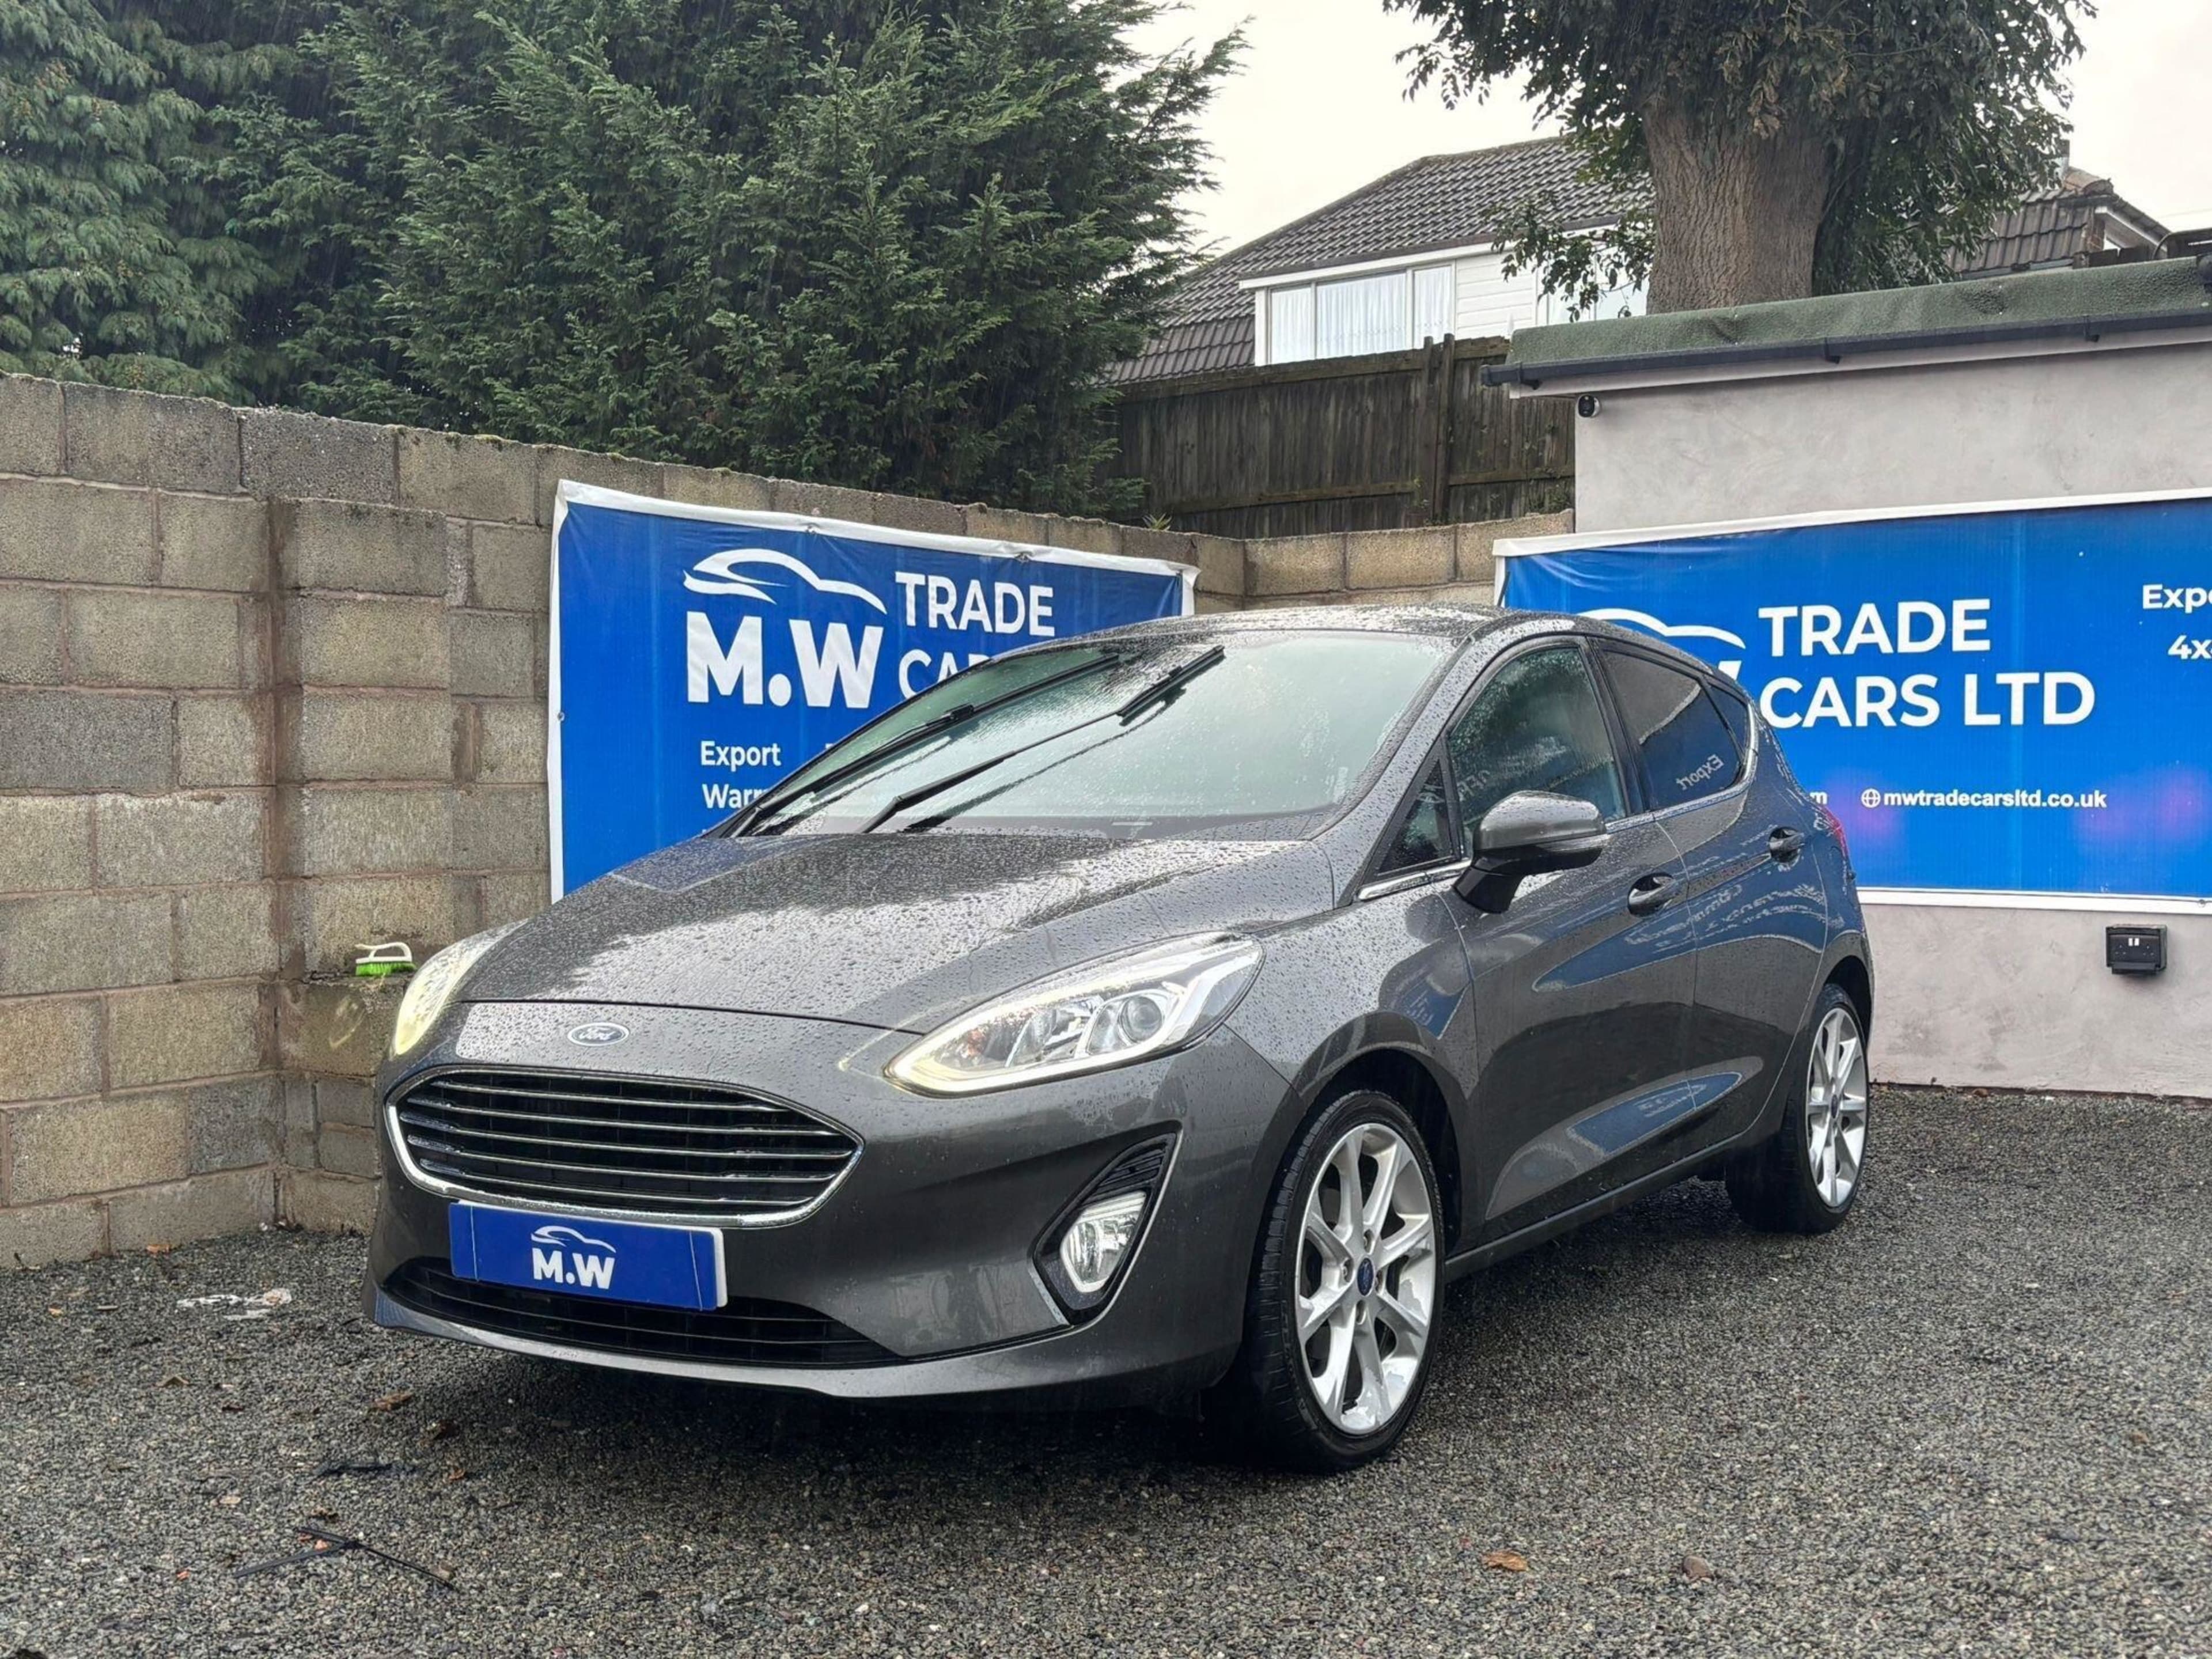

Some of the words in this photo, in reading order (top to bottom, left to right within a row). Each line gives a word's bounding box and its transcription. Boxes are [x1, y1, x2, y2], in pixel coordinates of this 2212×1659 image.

[895, 571, 1055, 637] TRADE
[2142, 584, 2212, 614] Exp
[1758, 598, 1991, 657] TRADE
[2168, 634, 2212, 660] 4x
[687, 611, 884, 709] M.W
[1759, 676, 1940, 729] CARS
[1964, 671, 2096, 726] LTD
[700, 740, 782, 772] Export
[1883, 789, 2108, 808] mwtradecarsltd.co.uk
[532, 1248, 615, 1290] M.W
